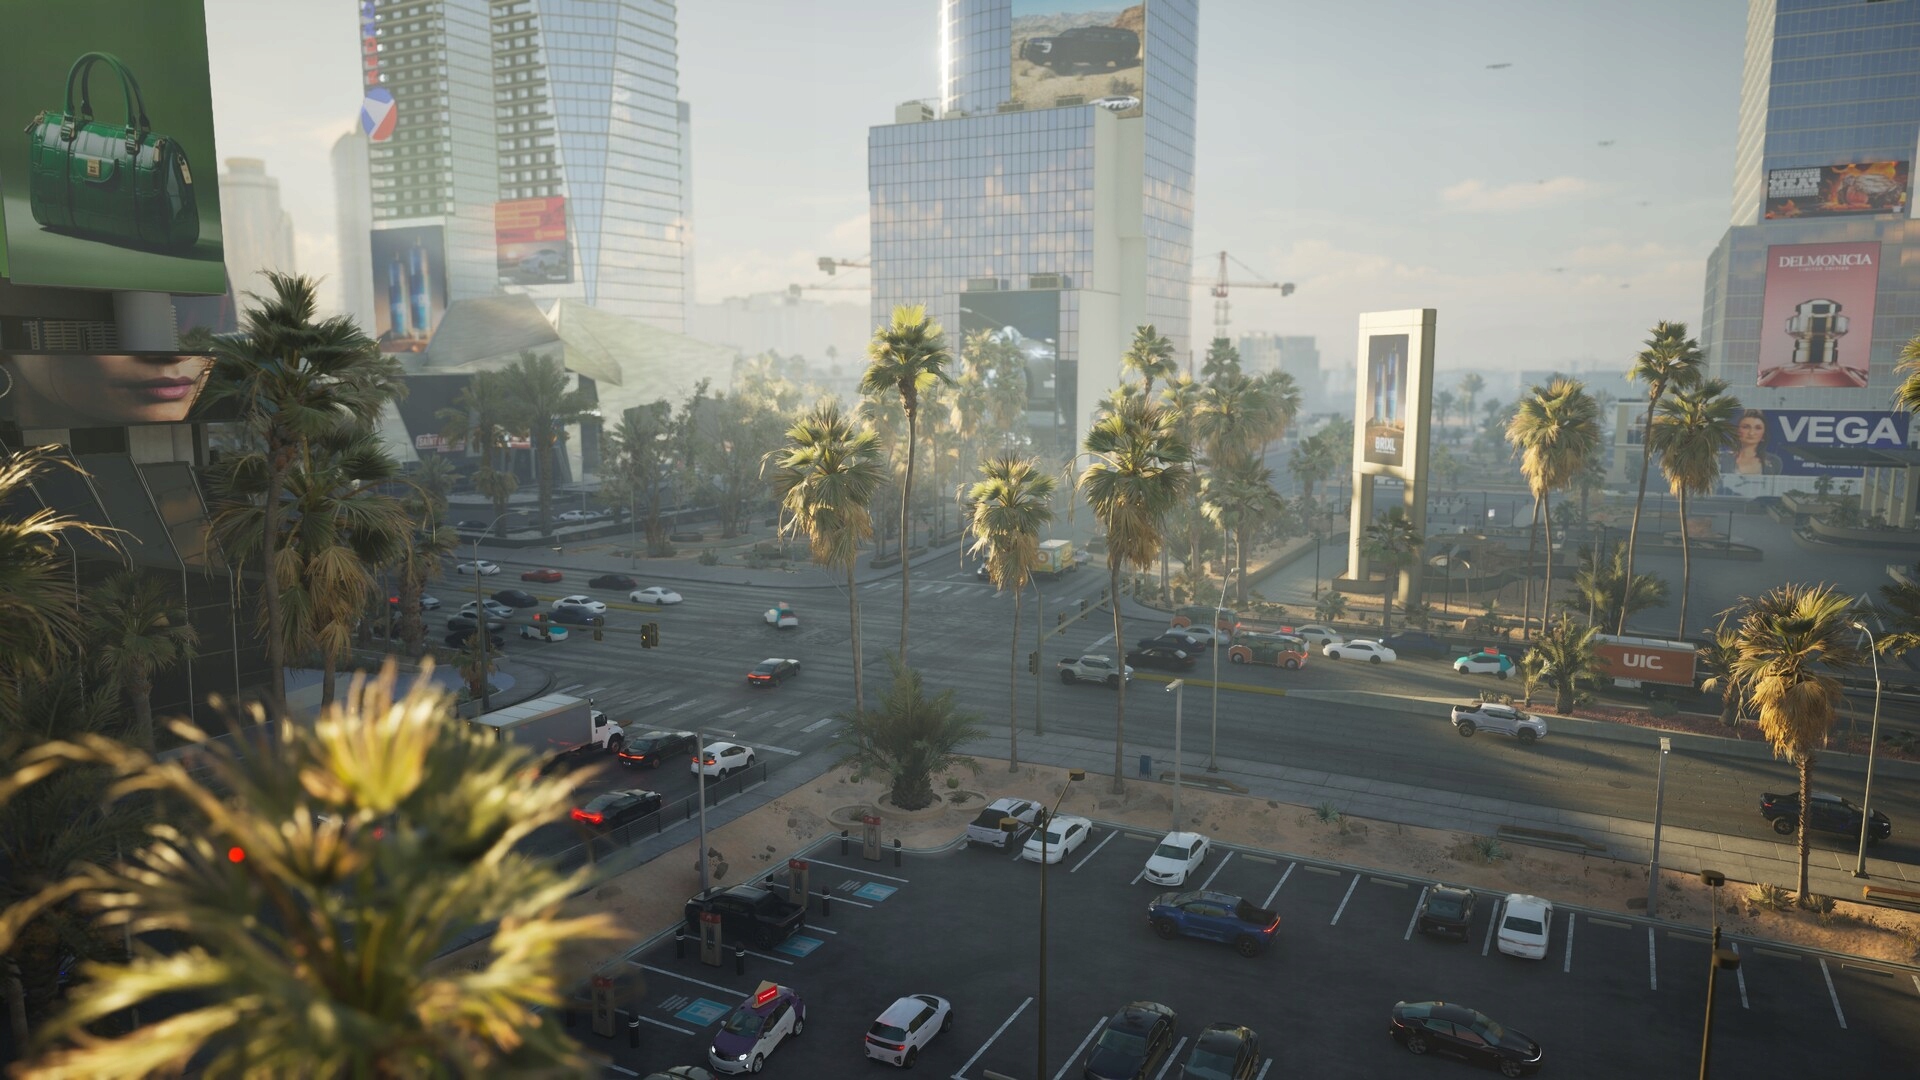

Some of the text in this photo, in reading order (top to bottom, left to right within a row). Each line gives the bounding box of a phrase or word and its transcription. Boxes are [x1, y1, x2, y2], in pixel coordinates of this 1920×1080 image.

[1769, 178, 1821, 190] MEAT
[1779, 254, 1872, 268] DELMONICIA
[1778, 416, 1902, 445] VEGA
[1623, 653, 1664, 670] UIC
